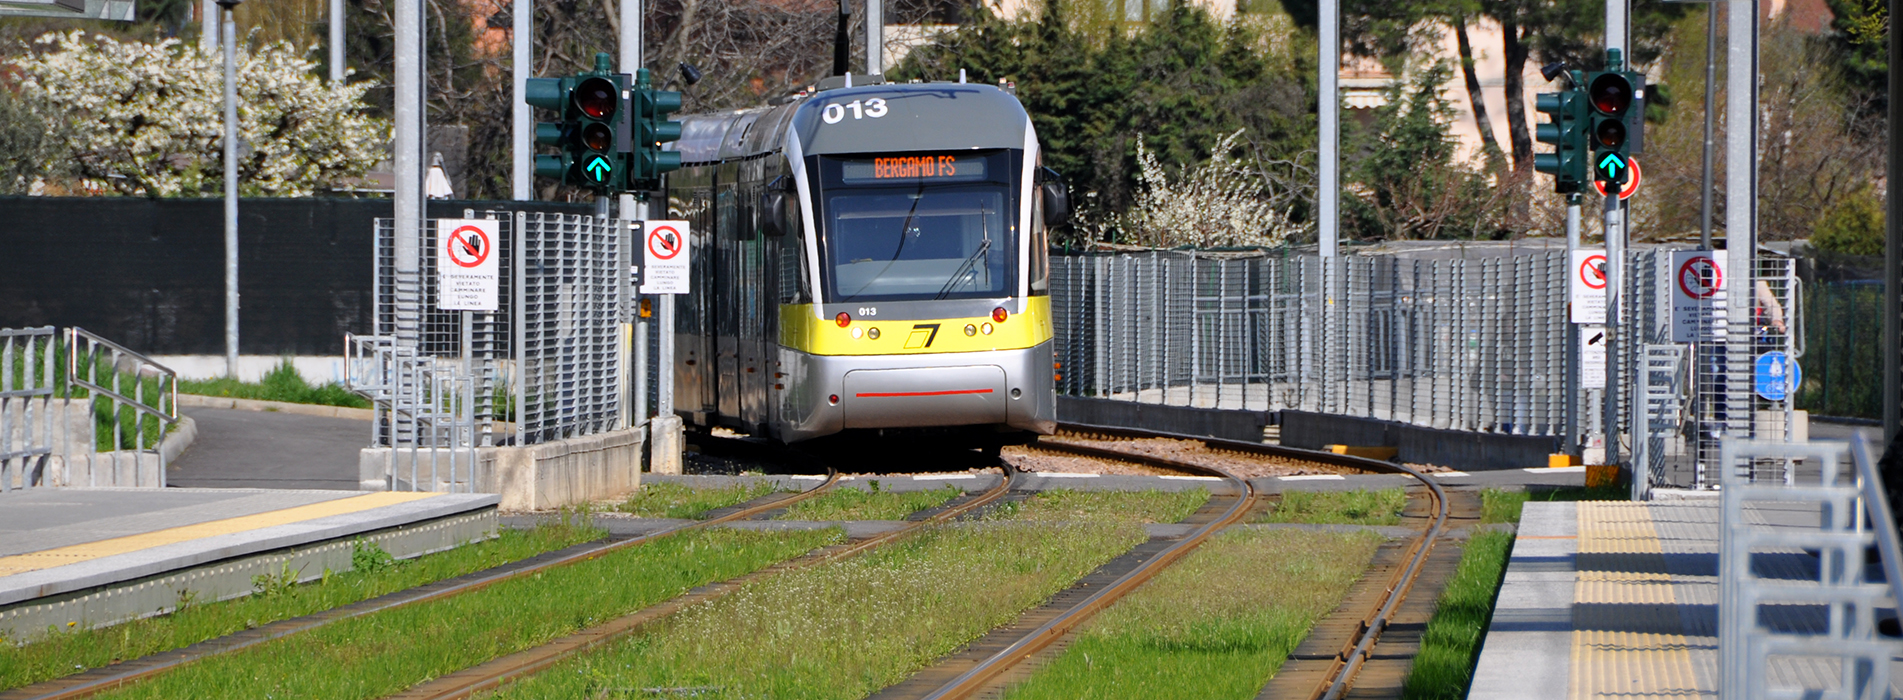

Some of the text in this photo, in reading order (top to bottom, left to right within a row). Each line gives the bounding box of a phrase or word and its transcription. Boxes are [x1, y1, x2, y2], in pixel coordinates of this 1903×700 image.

[822, 97, 888, 124] 013
[874, 155, 956, 178] BERGAMO FS
[858, 307, 877, 316] 013
